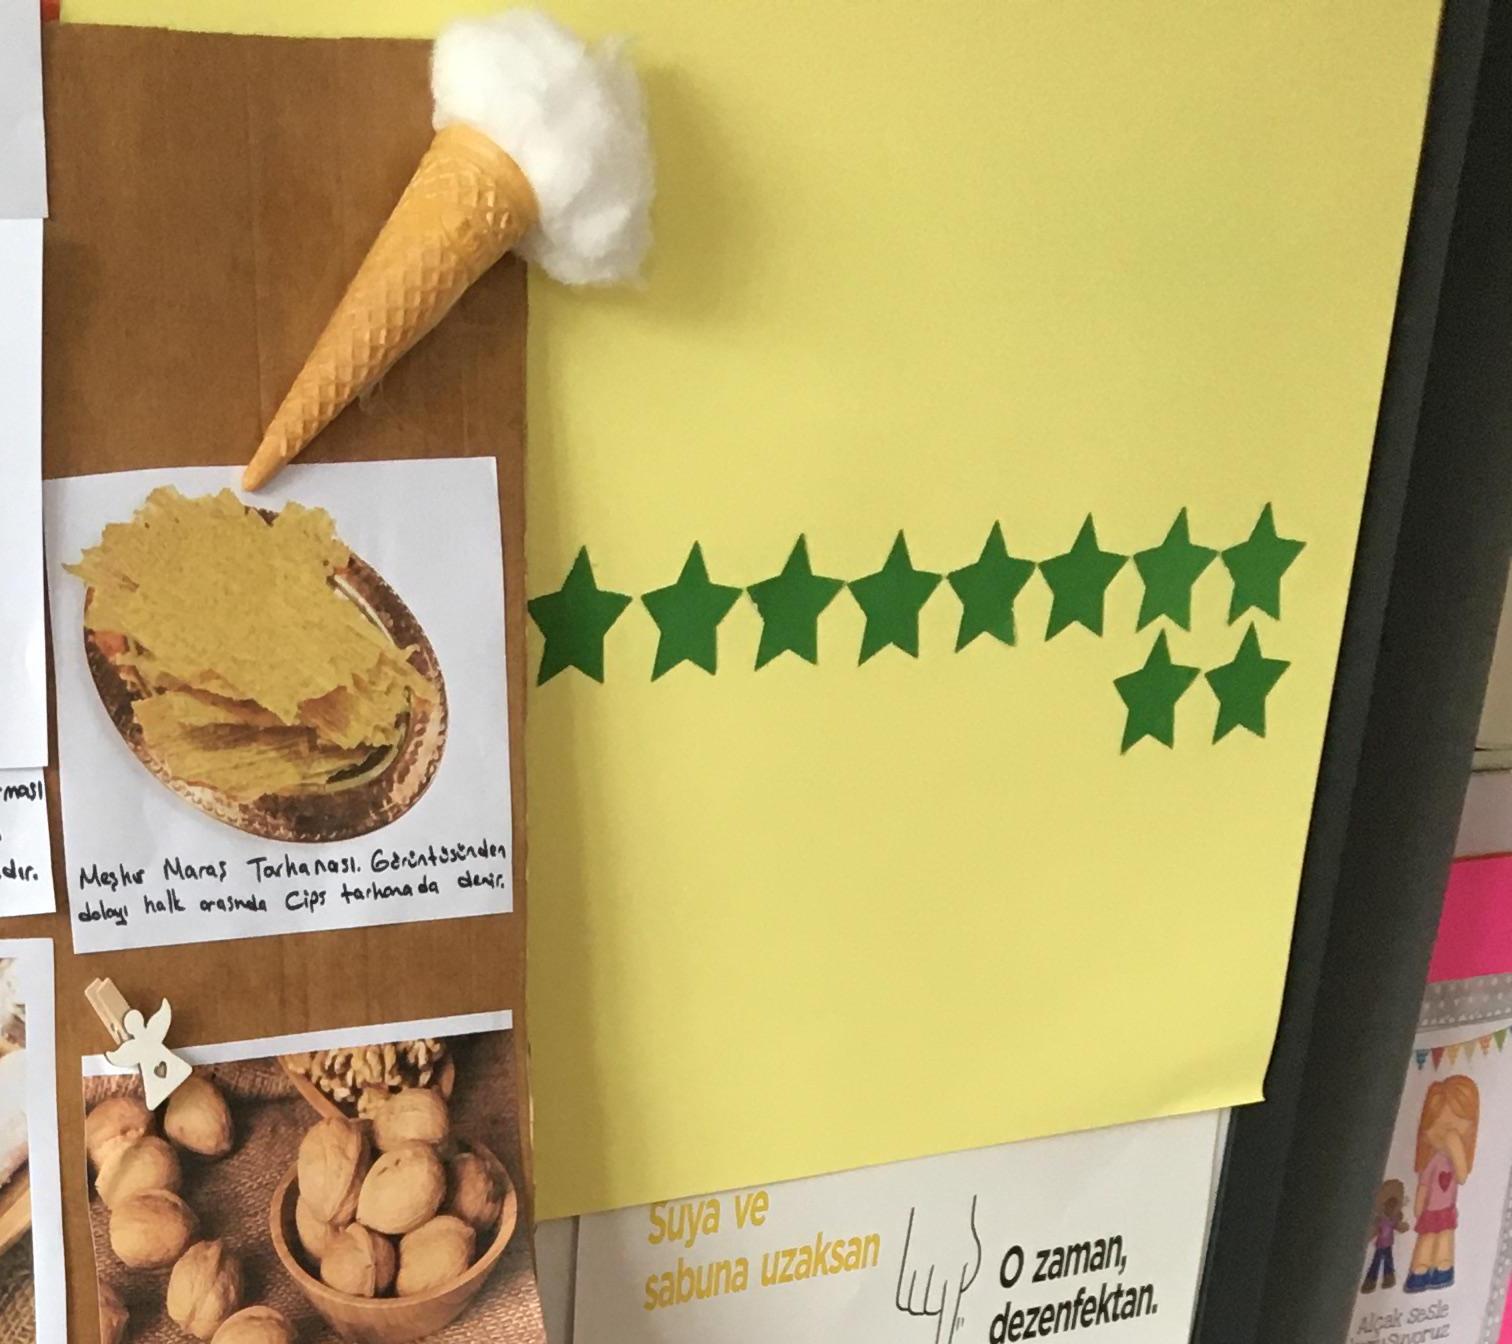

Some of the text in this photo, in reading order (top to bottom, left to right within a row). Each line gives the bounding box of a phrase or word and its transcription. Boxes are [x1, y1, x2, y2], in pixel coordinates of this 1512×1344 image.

[162, 856, 227, 883] Maraş
[143, 888, 327, 915] halk Cips
[648, 1190, 769, 1248] Suya ve
[644, 1230, 881, 1312] sabuna uzaksan
[998, 1233, 1129, 1288] O zaman,
